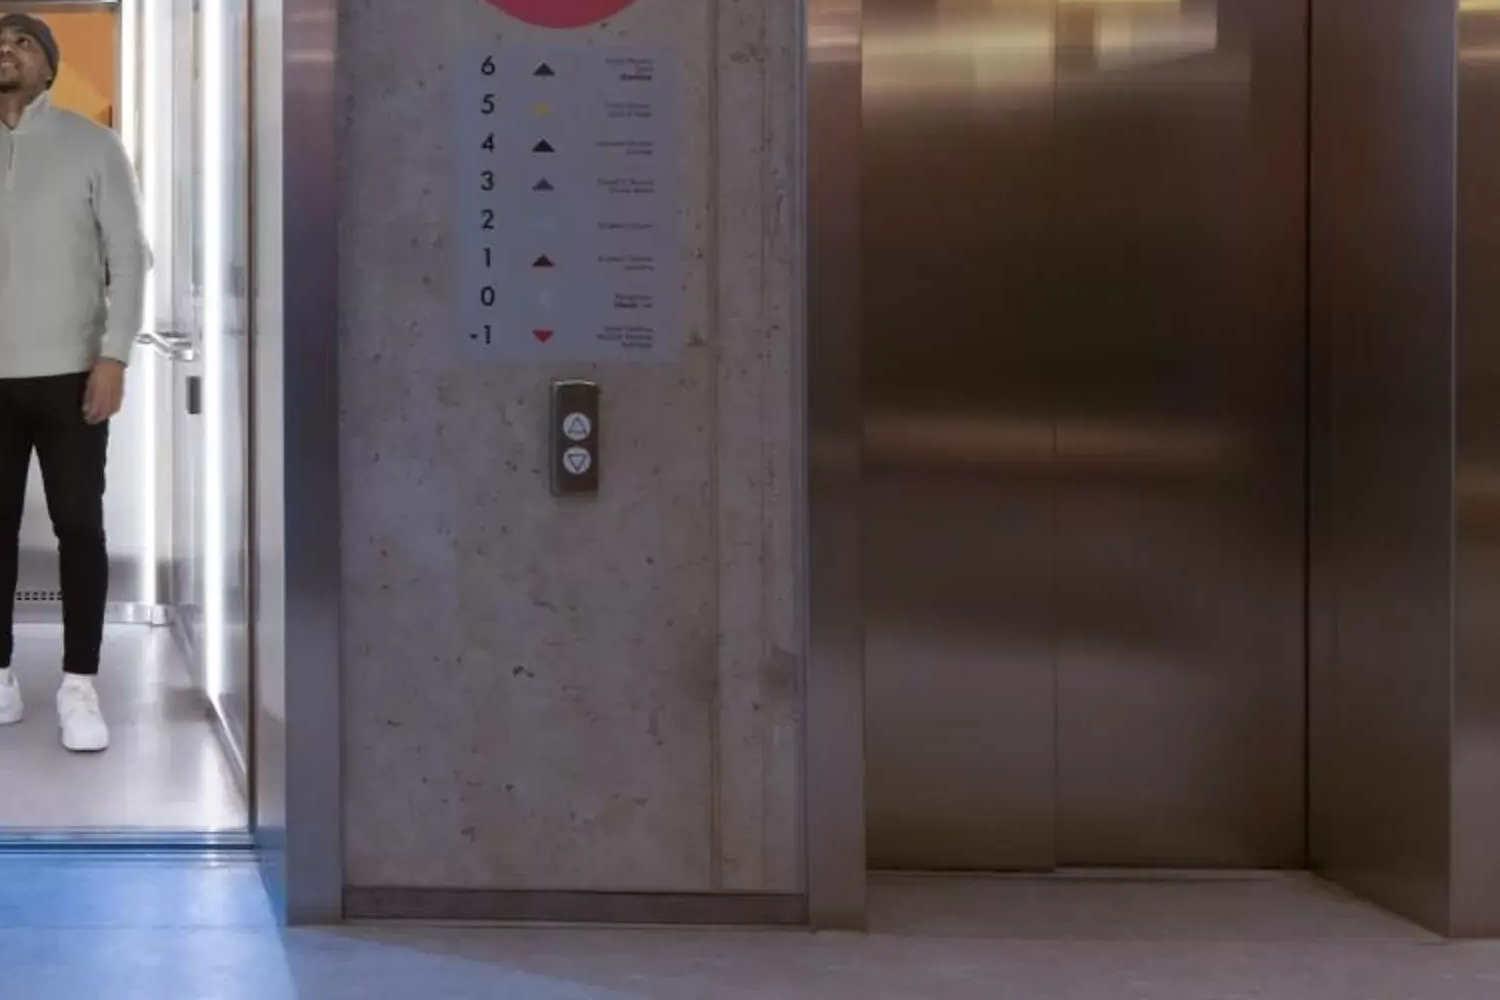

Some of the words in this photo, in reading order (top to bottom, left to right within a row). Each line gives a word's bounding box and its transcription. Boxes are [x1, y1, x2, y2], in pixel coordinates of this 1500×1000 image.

[480, 55, 496, 76] 6
[480, 93, 495, 115] 5
[481, 132, 495, 153] 4
[480, 170, 495, 191] 3
[481, 208, 495, 230] 2
[483, 247, 491, 268] 1
[480, 285, 496, 307] 0
